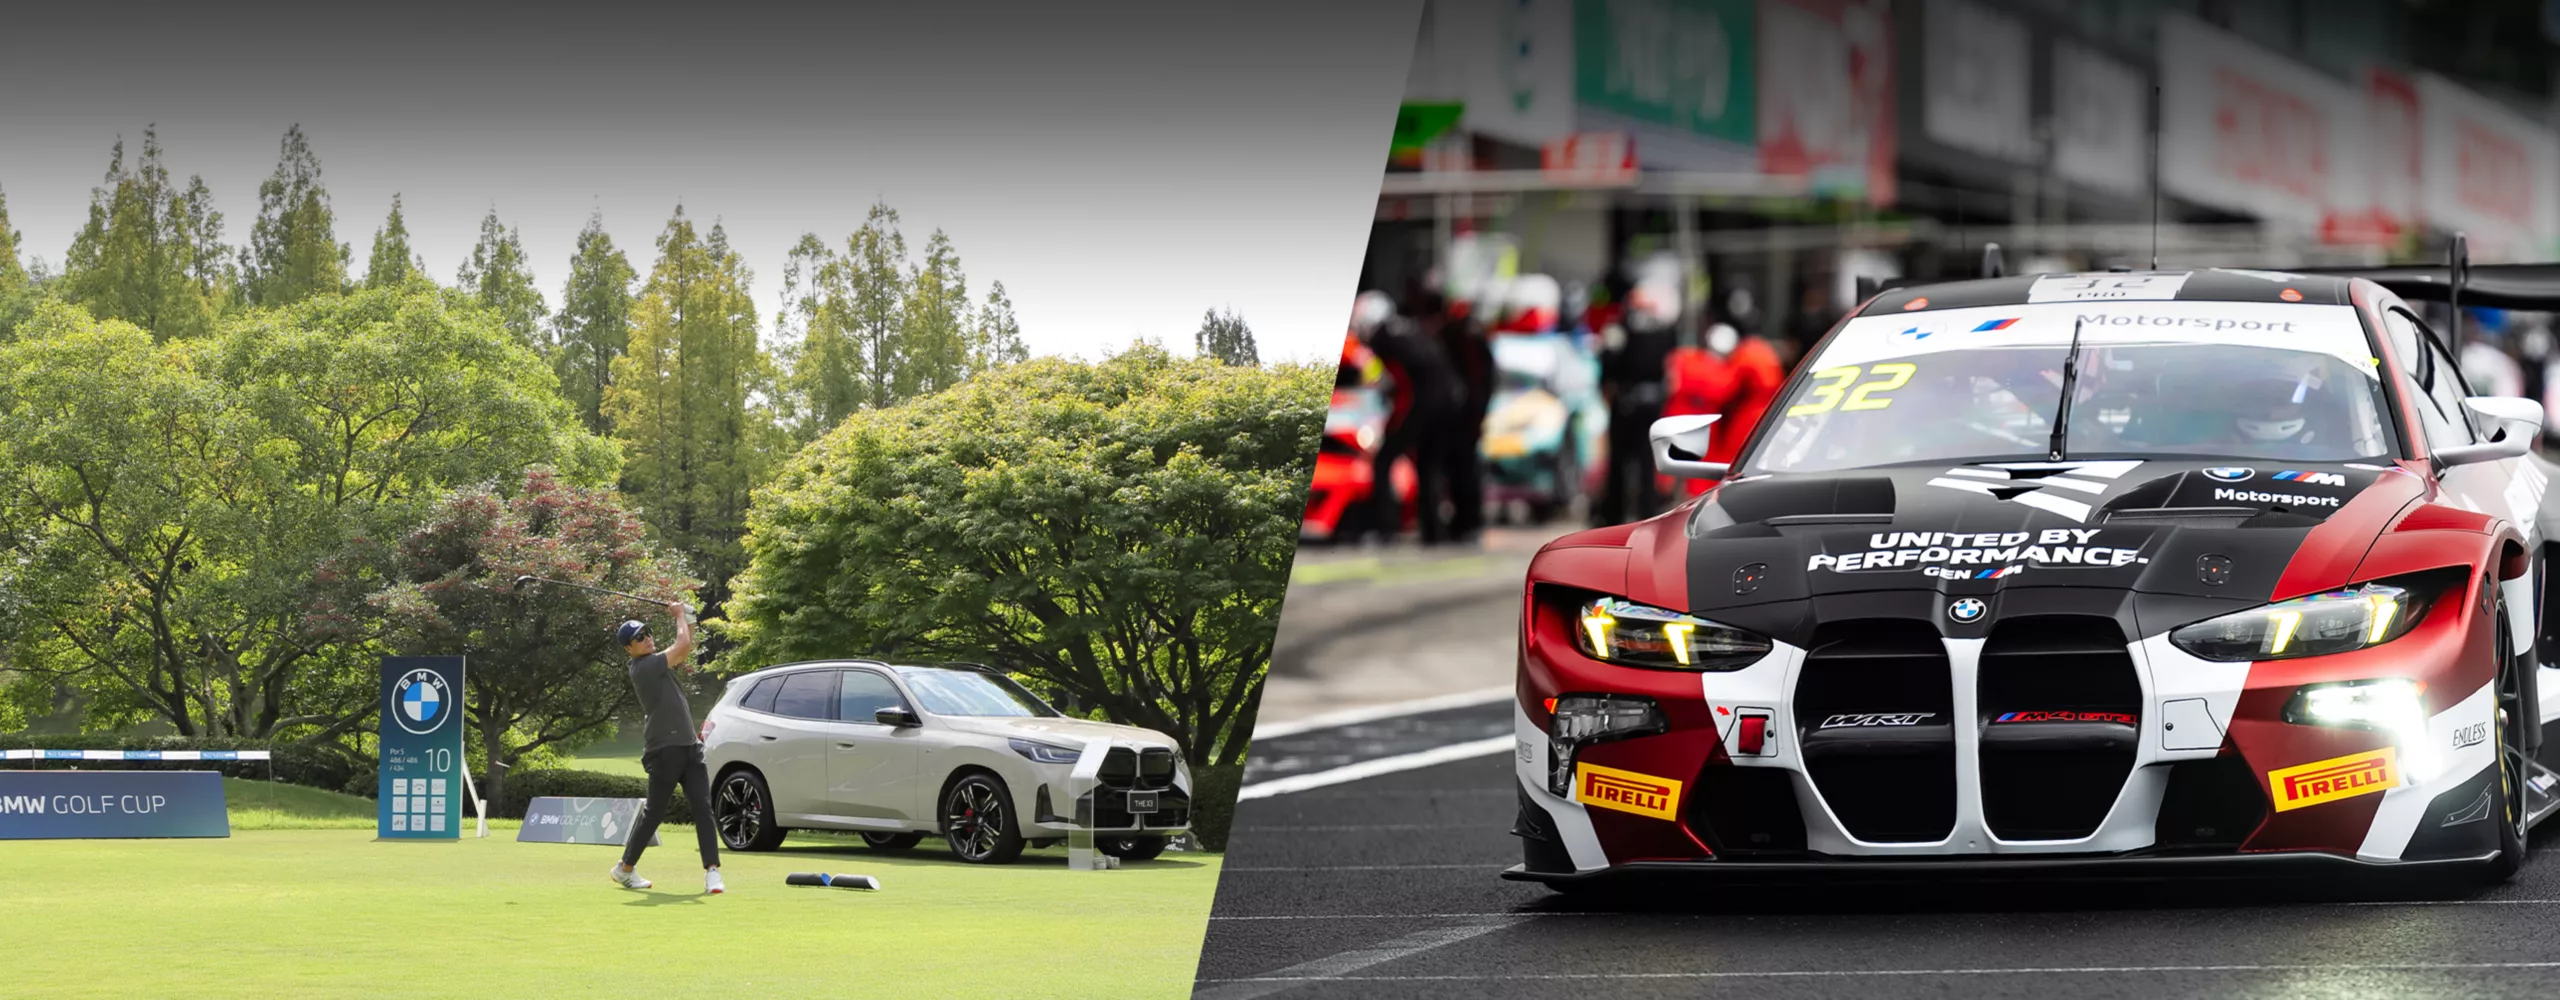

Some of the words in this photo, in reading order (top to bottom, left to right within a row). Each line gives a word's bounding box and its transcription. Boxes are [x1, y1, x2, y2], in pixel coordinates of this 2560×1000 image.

[2076, 314, 2298, 333] Motorsport
[1786, 362, 1917, 417] 32
[2214, 488, 2340, 507] Motorsport
[1869, 532, 2030, 549] UNITED
[2038, 528, 2102, 545] BY
[1923, 566, 1972, 580] GEN
[400, 672, 443, 691] BMW
[1821, 713, 1936, 728] WRT
[2453, 721, 2486, 747] ENDLESS
[425, 748, 451, 772] 10
[2283, 757, 2387, 801] PIRELLI
[1585, 772, 1671, 811] PIRELLI
[0, 795, 46, 814] MW
[53, 795, 115, 814] GOLF
[121, 795, 166, 814] CUP
[540, 815, 560, 825] BMW
